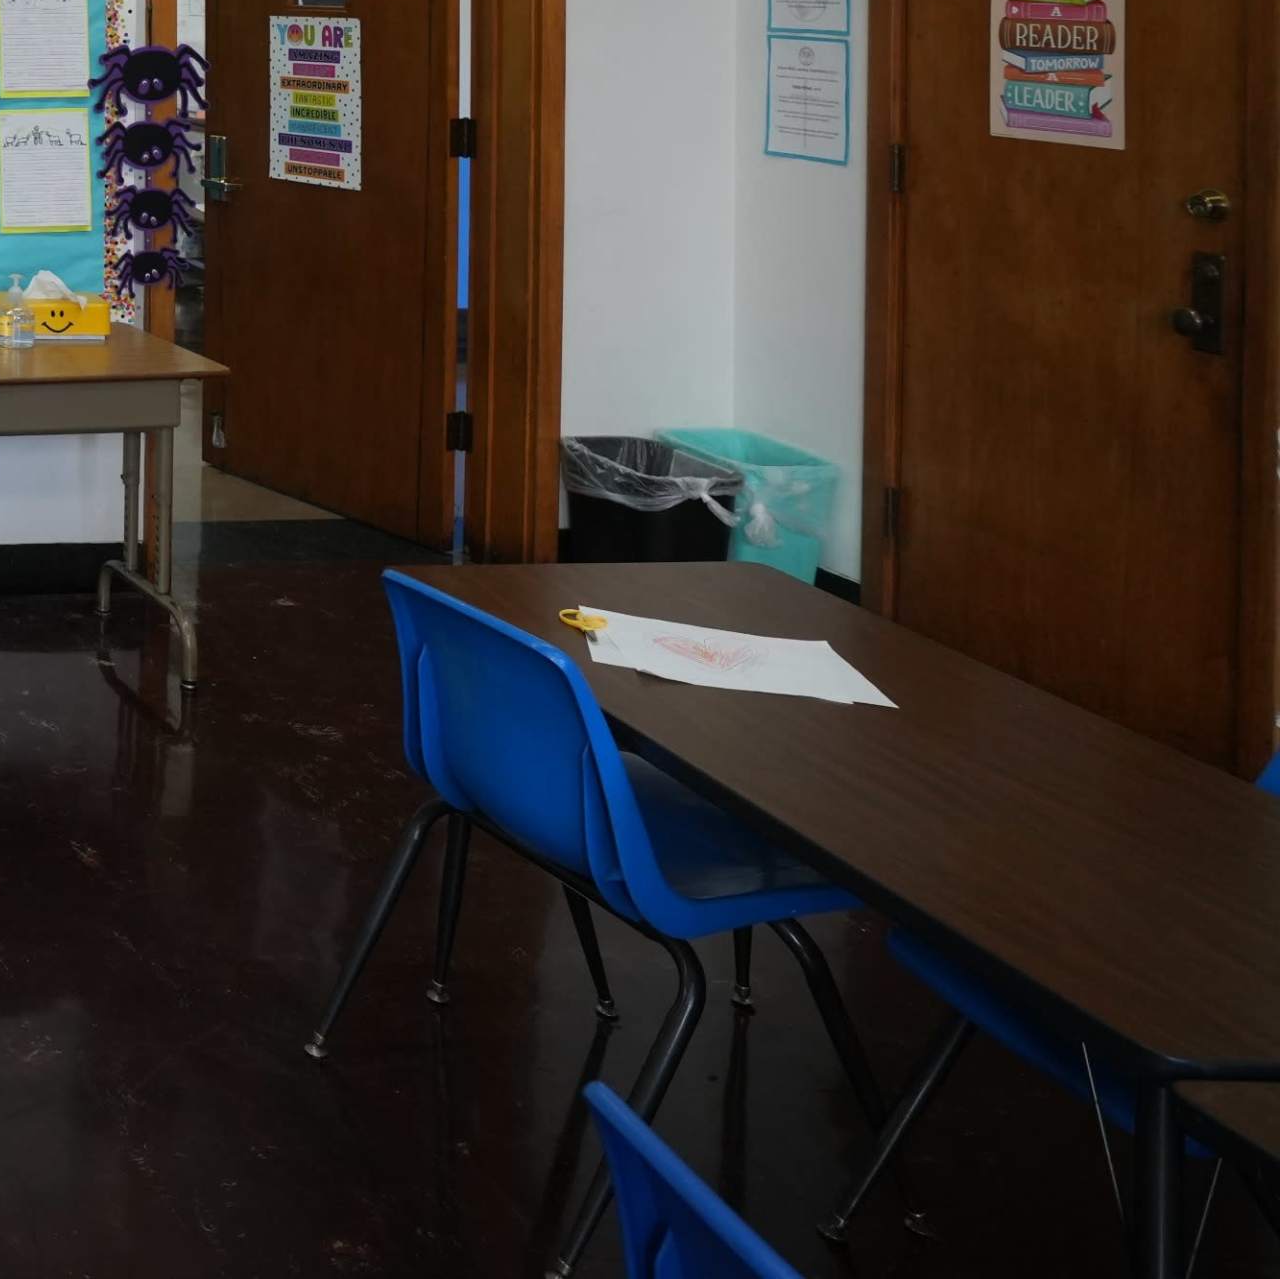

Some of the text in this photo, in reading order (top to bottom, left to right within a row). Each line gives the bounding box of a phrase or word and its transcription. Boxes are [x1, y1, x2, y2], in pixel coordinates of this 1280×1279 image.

[1051, 7, 1062, 17] A
[276, 23, 353, 48] YOU ARE
[1015, 23, 1099, 51] READER
[1030, 57, 1100, 72] TOMORROW
[1047, 72, 1059, 81] A
[281, 79, 348, 91] EXTRAORDINARY
[1014, 87, 1076, 112] LEADER
[291, 107, 337, 120] INCREDIBLE
[287, 165, 343, 179] UNSTOPPABLE
